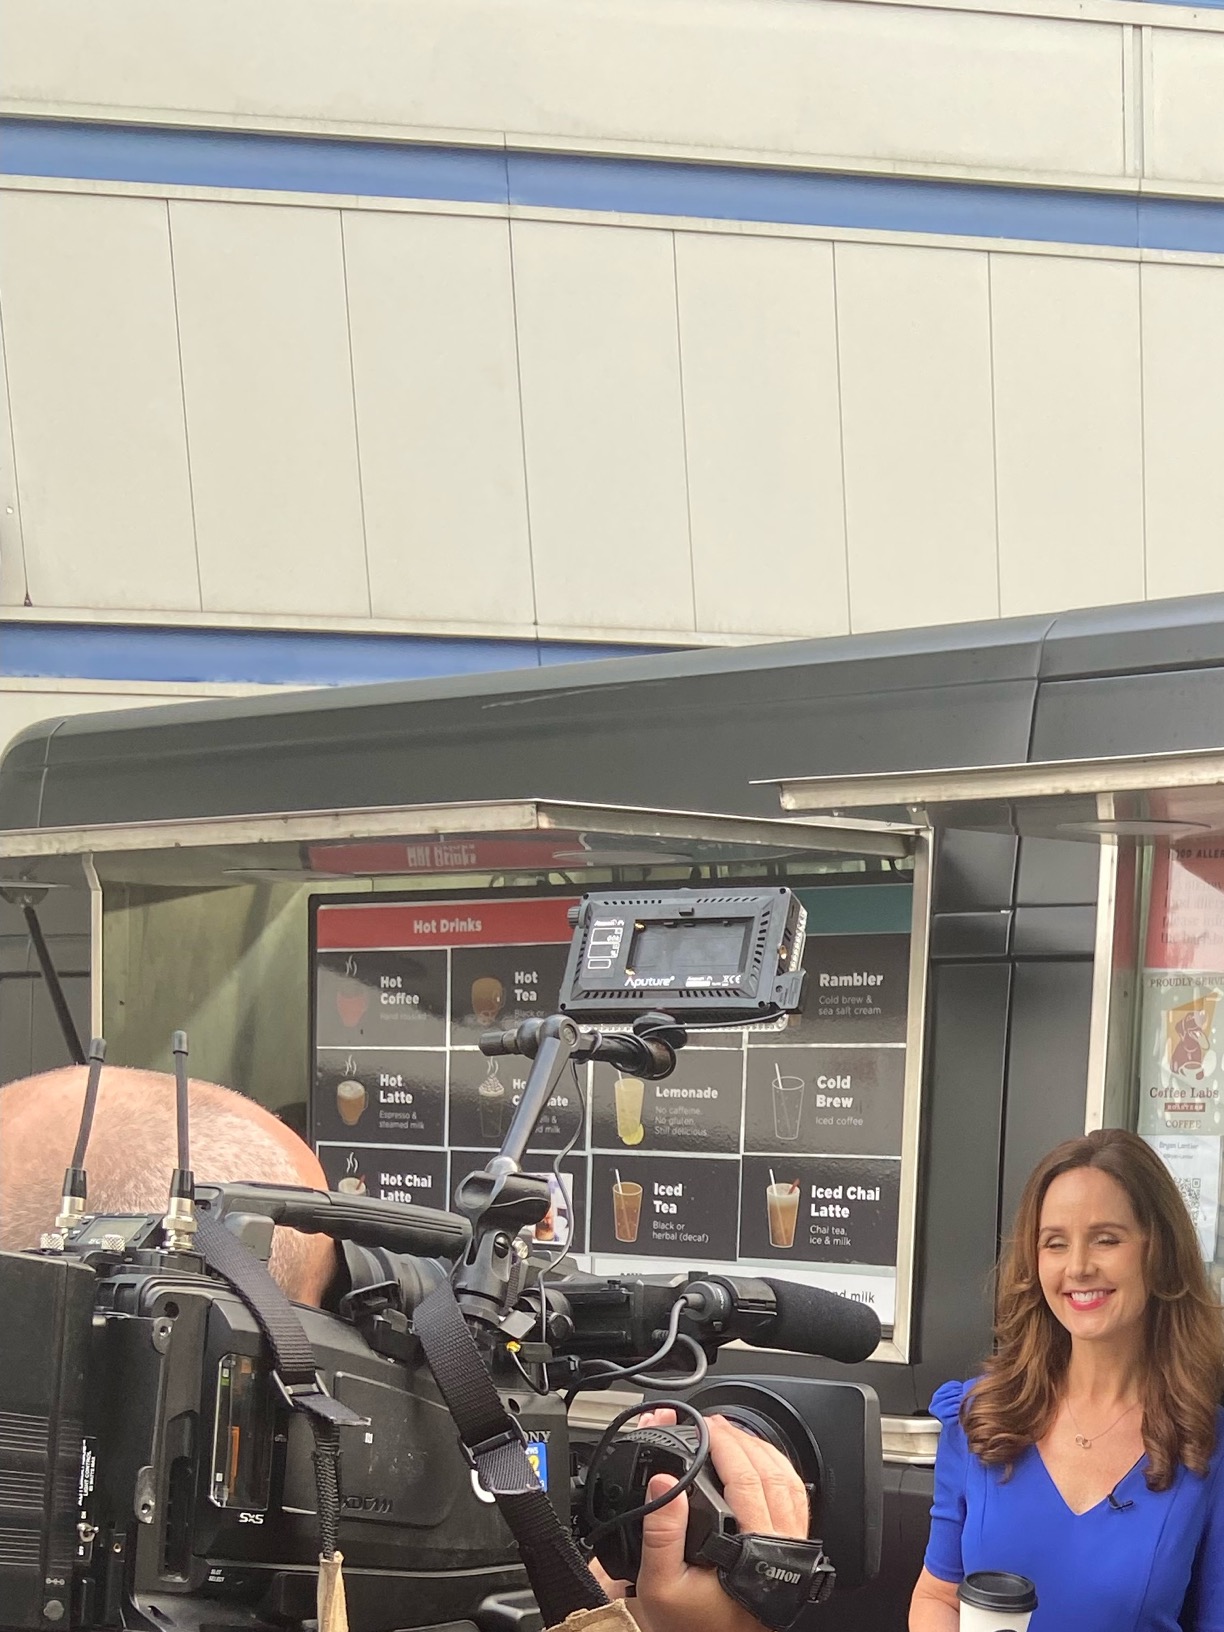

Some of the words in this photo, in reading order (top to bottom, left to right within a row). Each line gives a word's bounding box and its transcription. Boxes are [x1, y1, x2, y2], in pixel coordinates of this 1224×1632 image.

[413, 919, 437, 934] Hot
[440, 917, 482, 932] Drinks
[380, 976, 403, 988] Hot
[514, 971, 538, 984] Hot
[624, 976, 671, 989] Aputure
[819, 972, 883, 987] Rambler
[1150, 977, 1193, 987] PROUDLY
[380, 992, 420, 1005] Coffee
[514, 988, 537, 1001] Tea
[819, 995, 839, 1004] Cold
[842, 994, 863, 1004] brew
[866, 995, 873, 1004] &
[818, 1007, 833, 1015] sea
[836, 1006, 851, 1015] salt
[854, 1006, 882, 1015] cream
[380, 1074, 403, 1087] Hot
[512, 1078, 527, 1090] Ho
[817, 1075, 851, 1089] Cold
[380, 1091, 413, 1104] Latte
[656, 1086, 719, 1099] Lemonade
[1150, 1087, 1186, 1100] Coffee
[1191, 1087, 1219, 1099] Labs
[816, 1094, 853, 1109] Brew
[379, 1110, 410, 1121] Espresso
[412, 1111, 417, 1119] &
[655, 1106, 667, 1114] No
[379, 1120, 408, 1129] steamed
[410, 1120, 425, 1130] milk
[655, 1116, 666, 1124] No
[816, 1116, 834, 1126] Iced
[836, 1116, 863, 1126] coffee
[1165, 1119, 1202, 1129] COFFEE
[545, 1126, 561, 1134] milk
[380, 1173, 403, 1187] Hot
[405, 1174, 432, 1188] Chai
[380, 1190, 412, 1203] Latte
[653, 1183, 683, 1197] Iced
[811, 1185, 844, 1200] Iced
[847, 1186, 881, 1201] Chai
[653, 1200, 677, 1214] Tea
[810, 1204, 850, 1219] Latte
[653, 1221, 674, 1230] Black
[676, 1223, 685, 1231] or
[810, 1225, 829, 1235] Chai
[652, 1231, 677, 1241] herbal
[679, 1232, 709, 1244] (decaf)
[810, 1236, 822, 1245] ice
[824, 1237, 831, 1245] &
[833, 1236, 851, 1246] milk
[850, 1291, 875, 1303] milk
[524, 1430, 551, 1442] NY
[84, 1450, 92, 1478] CONTROL
[755, 1561, 801, 1585] Canon
